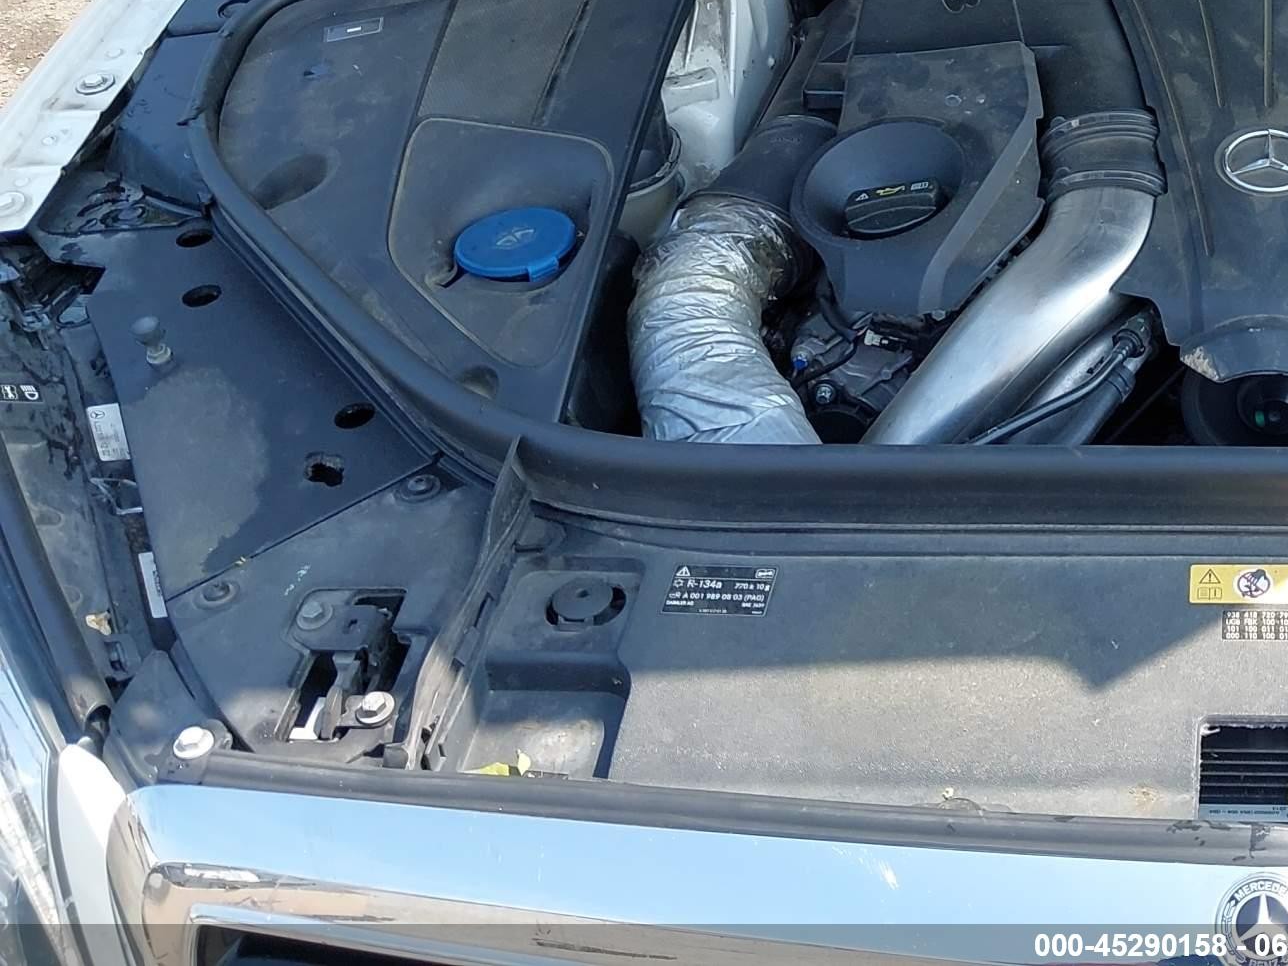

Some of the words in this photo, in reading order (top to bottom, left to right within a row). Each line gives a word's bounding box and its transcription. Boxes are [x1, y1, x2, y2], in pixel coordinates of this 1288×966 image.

[686, 579, 723, 589] R-134a
[682, 591, 689, 599] A
[690, 592, 705, 600] 001
[743, 594, 765, 602] (PAG)
[1261, 611, 1276, 619] 720
[1227, 625, 1240, 633] 101
[1244, 625, 1258, 633] 100
[1261, 625, 1275, 633] 011
